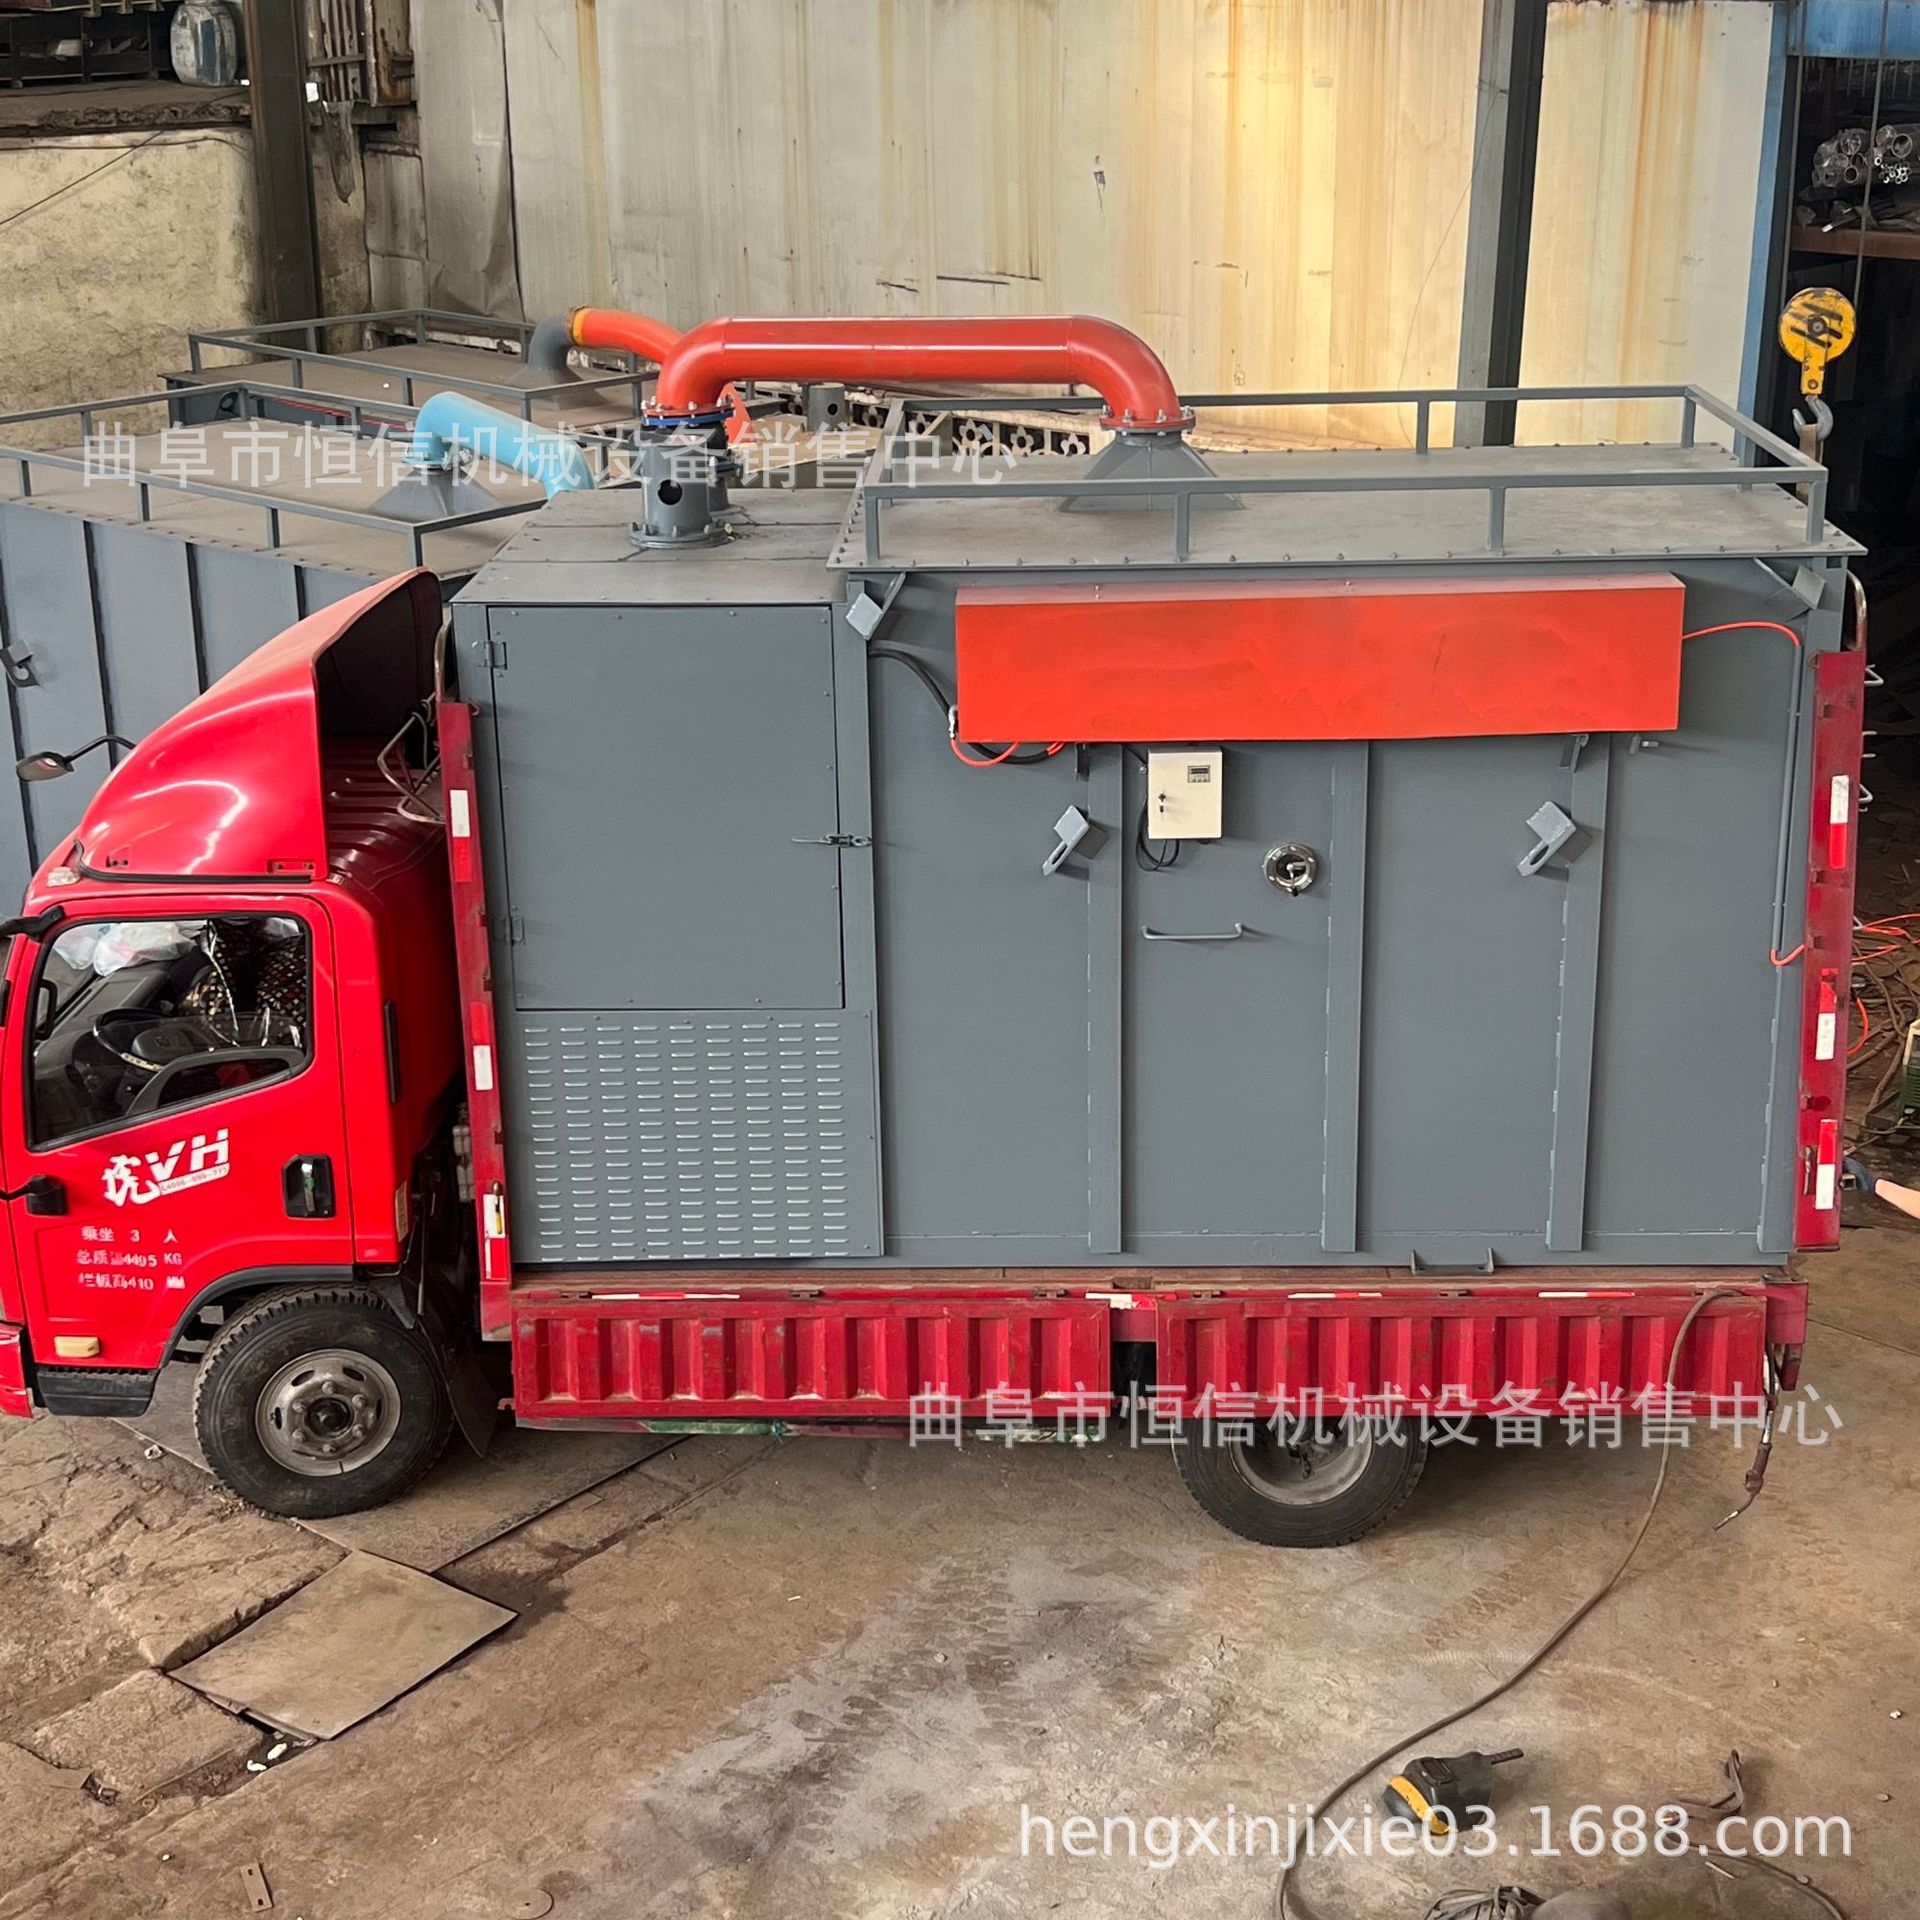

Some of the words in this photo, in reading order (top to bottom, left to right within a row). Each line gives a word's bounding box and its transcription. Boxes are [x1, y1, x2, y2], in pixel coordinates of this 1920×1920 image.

[130, 1229, 140, 1242] 3
[163, 1229, 178, 1243] 人
[163, 1252, 182, 1265] KG
